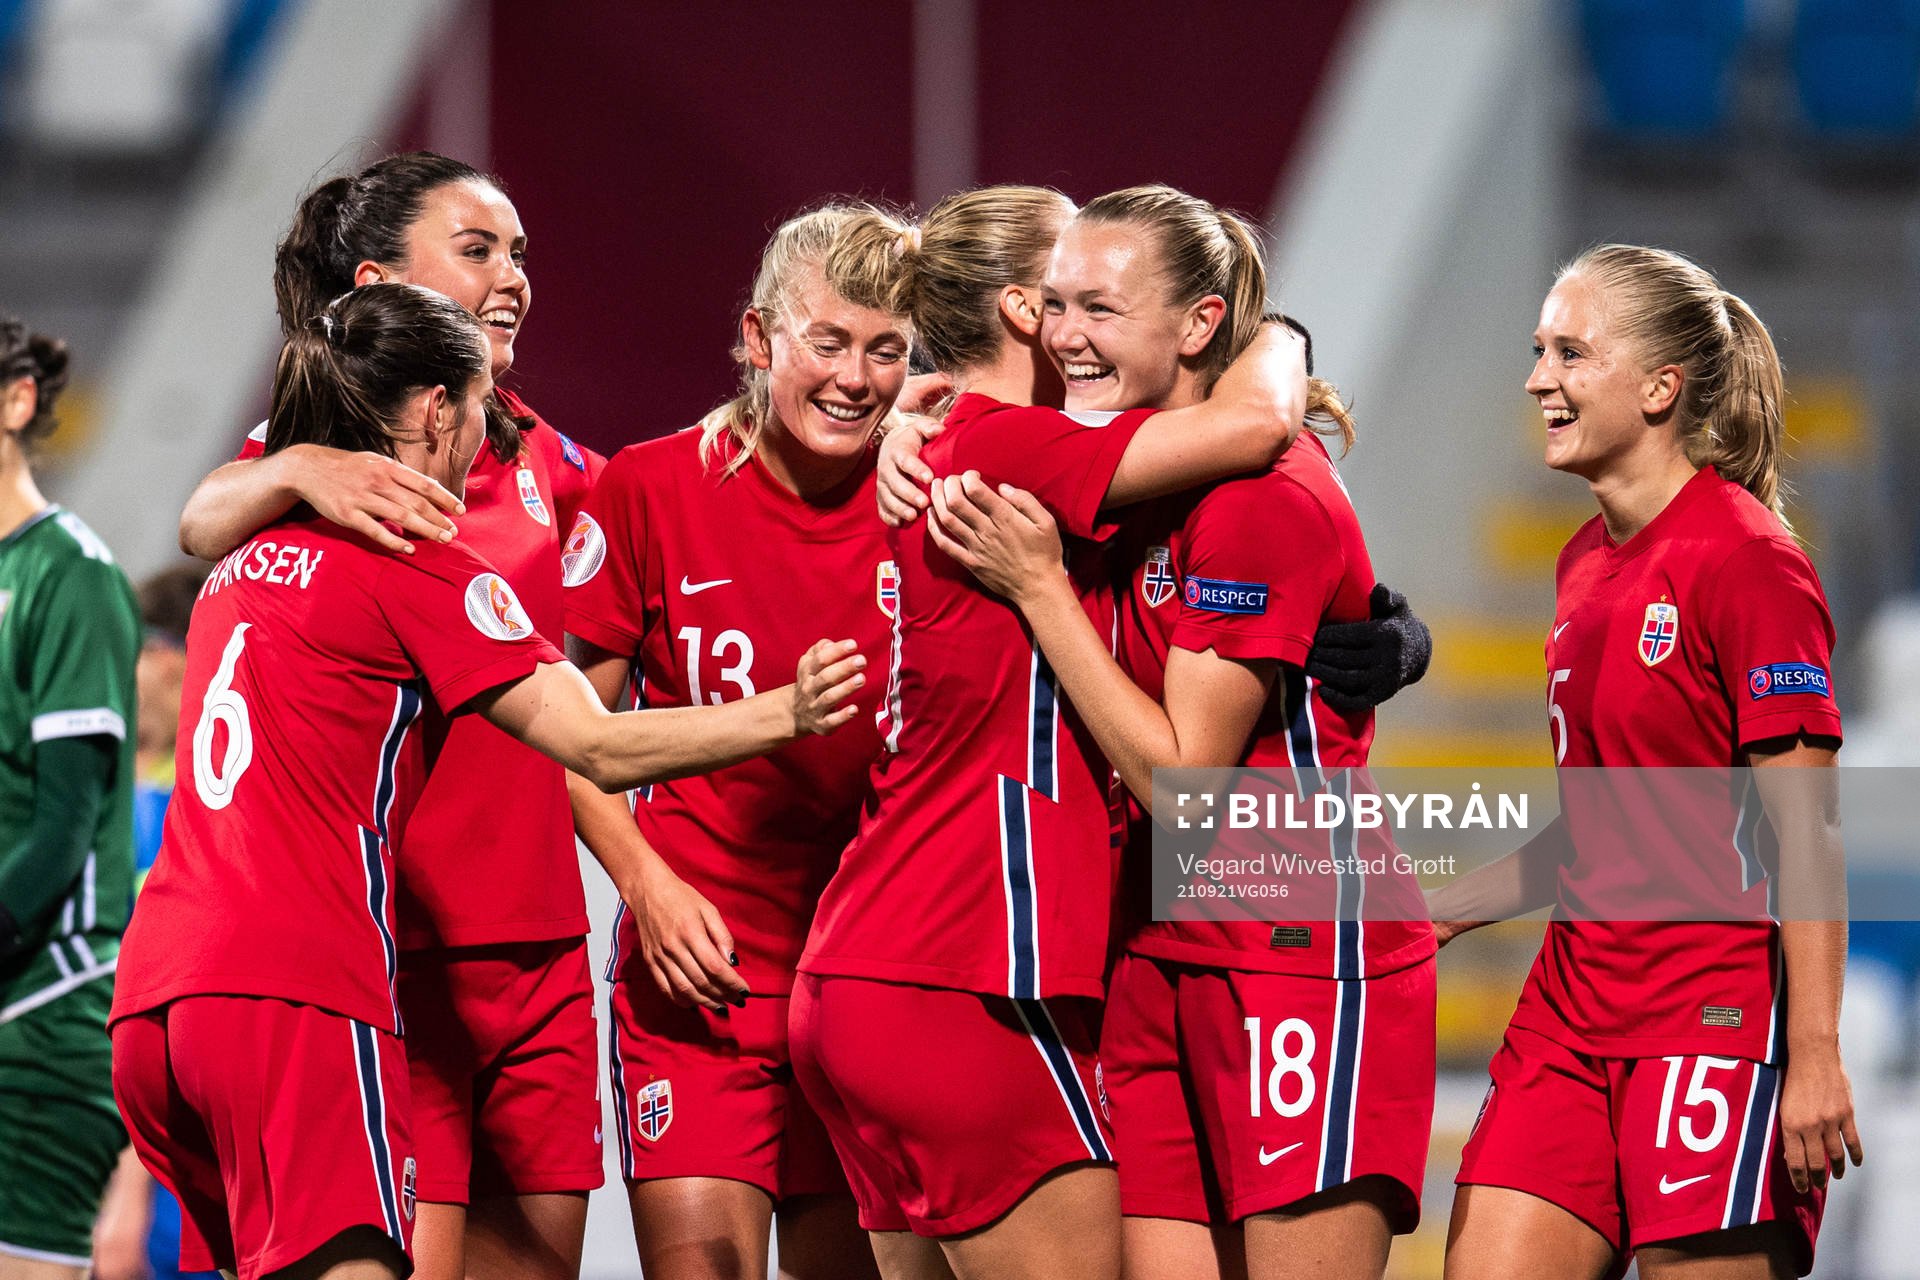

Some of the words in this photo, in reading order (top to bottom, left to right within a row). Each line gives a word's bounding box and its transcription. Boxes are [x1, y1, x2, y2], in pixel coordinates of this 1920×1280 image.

[199, 541, 324, 600] HANSEN
[1202, 589, 1267, 605] RESPECT
[677, 626, 755, 706] 13
[1773, 671, 1827, 688] RESPECT
[193, 622, 253, 810] 6
[1548, 668, 1572, 767] 5
[1244, 1016, 1316, 1118] 18
[1655, 1055, 1740, 1153] 15
